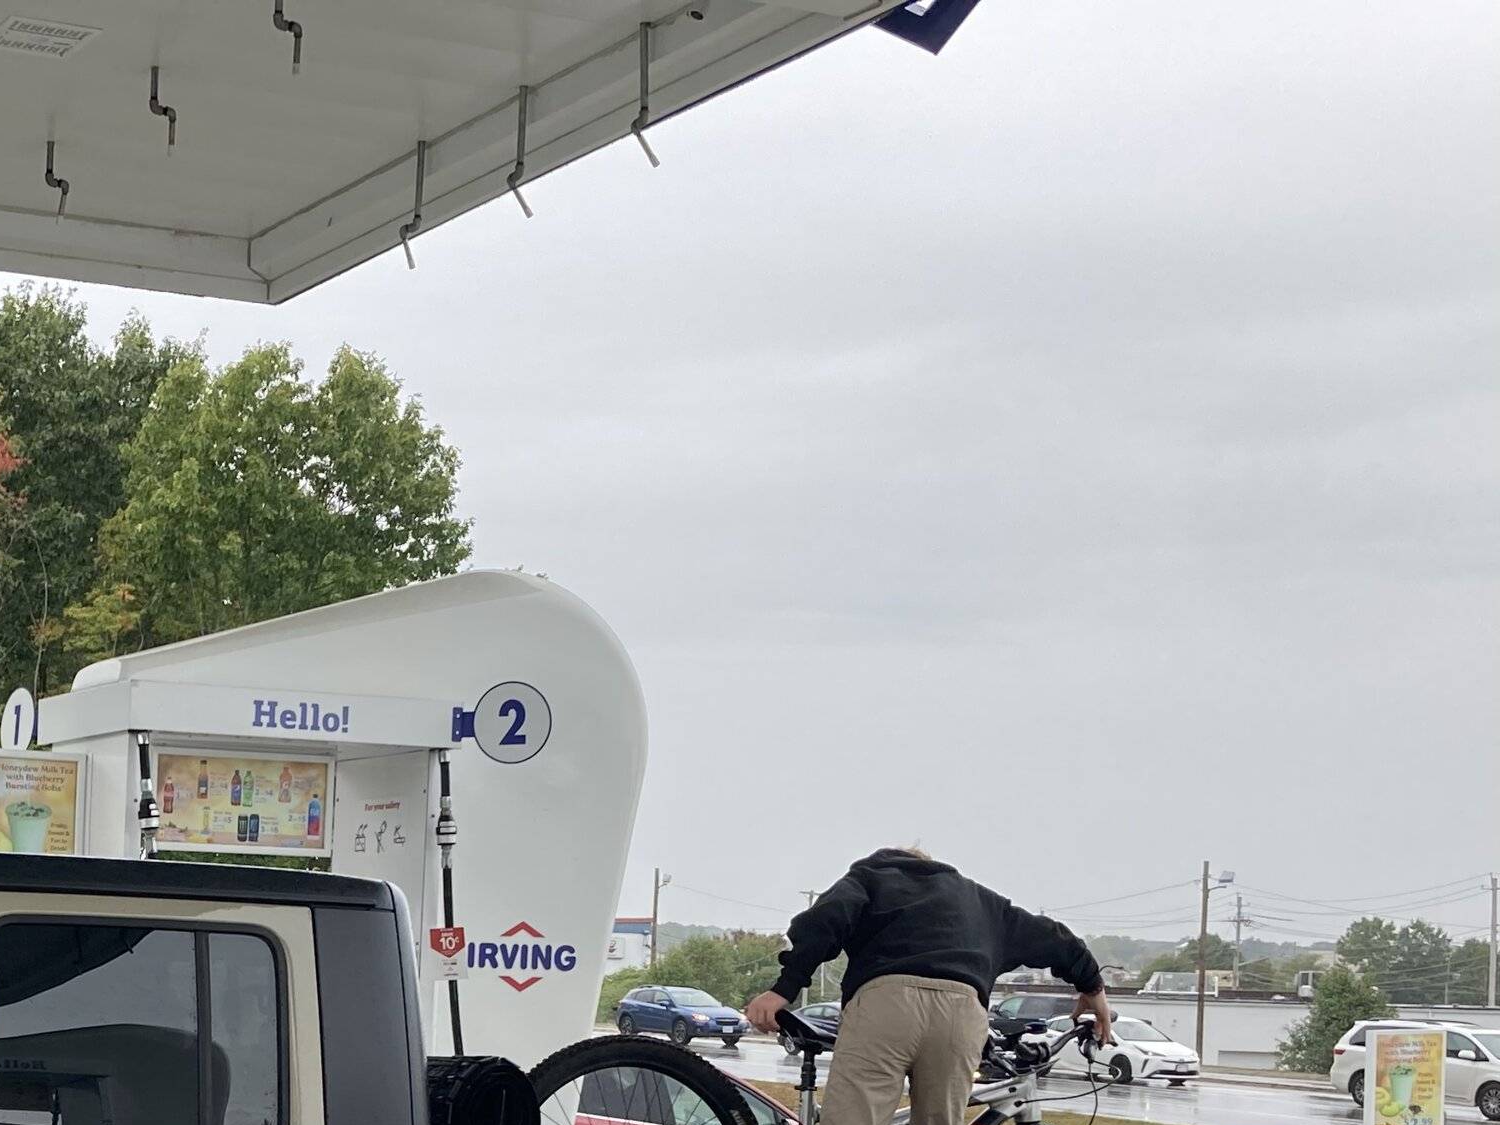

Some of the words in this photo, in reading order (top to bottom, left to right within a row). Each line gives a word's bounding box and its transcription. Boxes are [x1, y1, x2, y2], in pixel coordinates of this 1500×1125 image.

[14, 704, 21, 746] 1
[252, 700, 350, 733] Hello!
[498, 699, 526, 746] 2
[41, 765, 59, 773] Milk
[467, 942, 577, 972] IRVING
